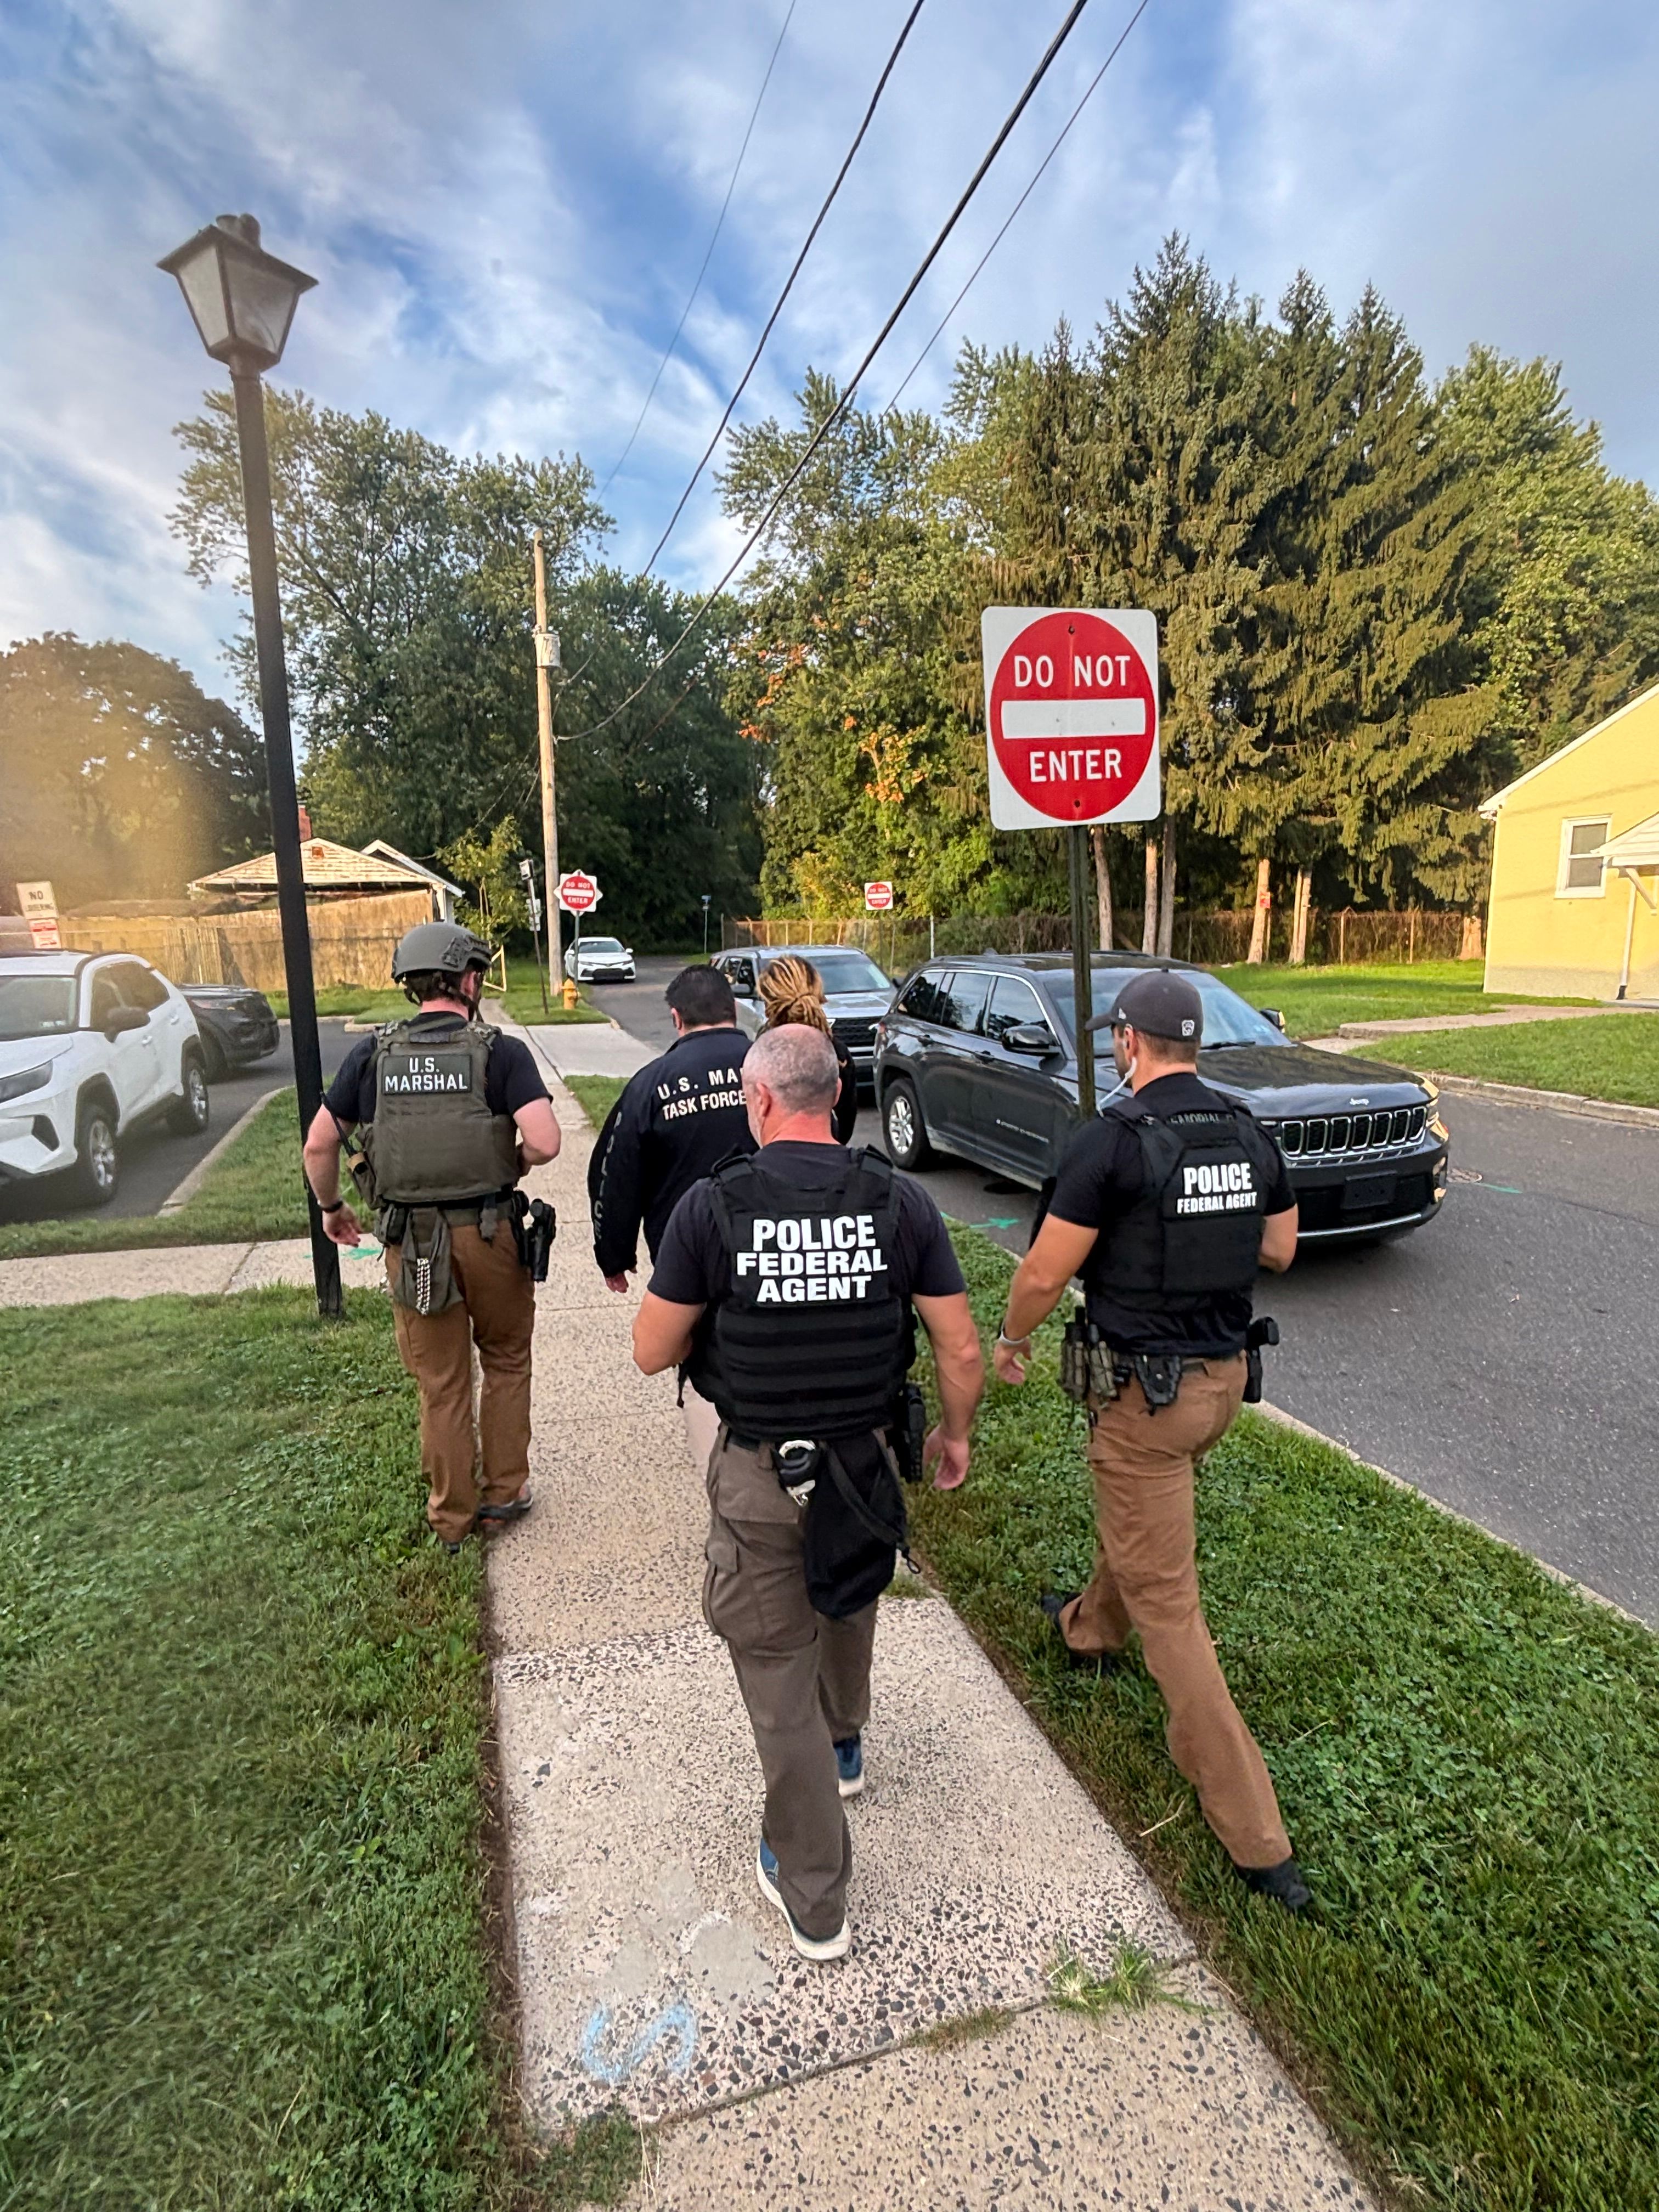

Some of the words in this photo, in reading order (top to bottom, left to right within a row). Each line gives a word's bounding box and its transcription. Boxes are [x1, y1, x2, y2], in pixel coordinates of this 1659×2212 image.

[1014, 655, 1053, 688] DO
[1074, 655, 1131, 687] NOT
[1029, 748, 1122, 782] ENTER
[29, 890, 43, 900] NO
[409, 1057, 440, 1073] U.S.
[385, 1074, 468, 1092] MARSHAL
[657, 1076, 699, 1100] U.S.
[662, 1097, 698, 1120] TASK
[700, 1090, 747, 1110] FORCE
[1183, 1163, 1252, 1195] POLICE
[1177, 1195, 1224, 1214] FEDERAL
[1226, 1192, 1257, 1209] AGENT
[753, 1215, 876, 1252] POLICE
[737, 1249, 888, 1276] FEDERAL
[757, 1275, 872, 1302] AGENT
